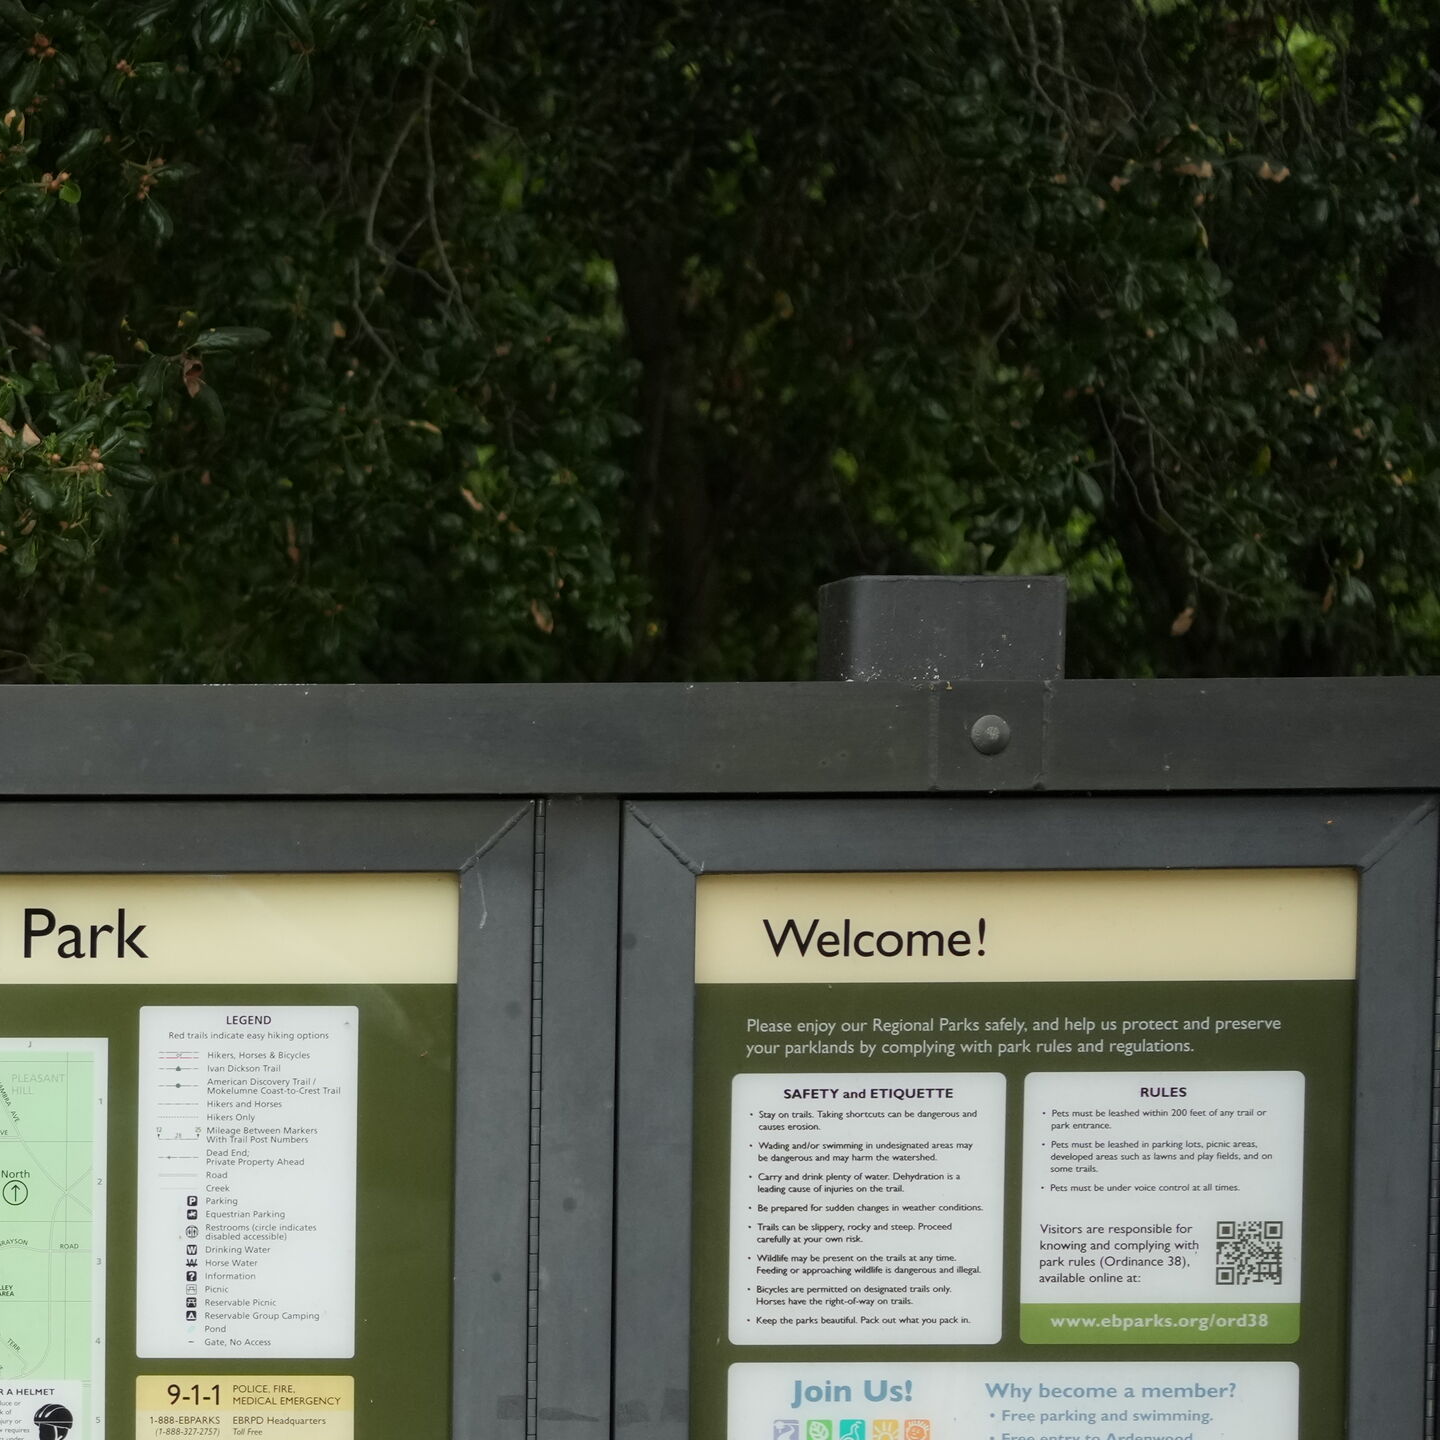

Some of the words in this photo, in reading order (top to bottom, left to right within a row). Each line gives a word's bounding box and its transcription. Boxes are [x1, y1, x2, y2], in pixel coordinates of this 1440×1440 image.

[23, 907, 149, 959] Park
[762, 917, 986, 958] Welcome!
[226, 1015, 272, 1026] LEGEND
[746, 1018, 792, 1033] Please
[796, 1019, 837, 1036] enjoy
[840, 1022, 868, 1033] our
[872, 1017, 934, 1036] Regional
[939, 1017, 980, 1032] Parks
[984, 1017, 1028, 1036] safely,
[1032, 1016, 1059, 1031] and
[1064, 1016, 1096, 1035] help
[1100, 1020, 1118, 1031] us
[1122, 1019, 1179, 1035] protect
[1183, 1016, 1210, 1031] and
[1215, 1019, 1282, 1034] preserve
[746, 1044, 781, 1059] your
[784, 1039, 855, 1058] parklands
[859, 1039, 877, 1058] by
[881, 1039, 956, 1058] complying
[959, 1039, 993, 1054] with
[998, 1039, 1032, 1057] park
[1036, 1038, 1073, 1053] rules
[1077, 1038, 1104, 1053] and
[1109, 1038, 1194, 1057] regulations.
[783, 1088, 840, 1100] SAFETY
[842, 1088, 866, 1099] and
[870, 1088, 954, 1101] ETIQUETTE
[1140, 1086, 1187, 1098] RULES
[1, 1169, 31, 1179] North
[205, 1196, 239, 1207] Parking
[205, 1245, 243, 1256] Drinking
[244, 1245, 271, 1254] Water
[1049, 1313, 1269, 1332] www.ebparks.org/ord38
[6, 1388, 14, 1396] A
[15, 1388, 55, 1396] HELMET
[167, 1383, 220, 1406] 9-1-1
[232, 1384, 271, 1394] POLICE,
[273, 1384, 296, 1394] FIRE,
[790, 1379, 852, 1409] Join
[863, 1379, 913, 1403] Us!
[984, 1382, 1033, 1403] Why
[1038, 1382, 1118, 1399] become
[1123, 1387, 1136, 1399] a
[1141, 1382, 1237, 1399] member?
[232, 1396, 277, 1406] MEDICAL
[279, 1396, 341, 1406] EMERGENCY
[1001, 1409, 1036, 1422] Free
[1040, 1409, 1097, 1425] parking
[1100, 1409, 1128, 1422] and
[1132, 1409, 1214, 1425] swimming.
